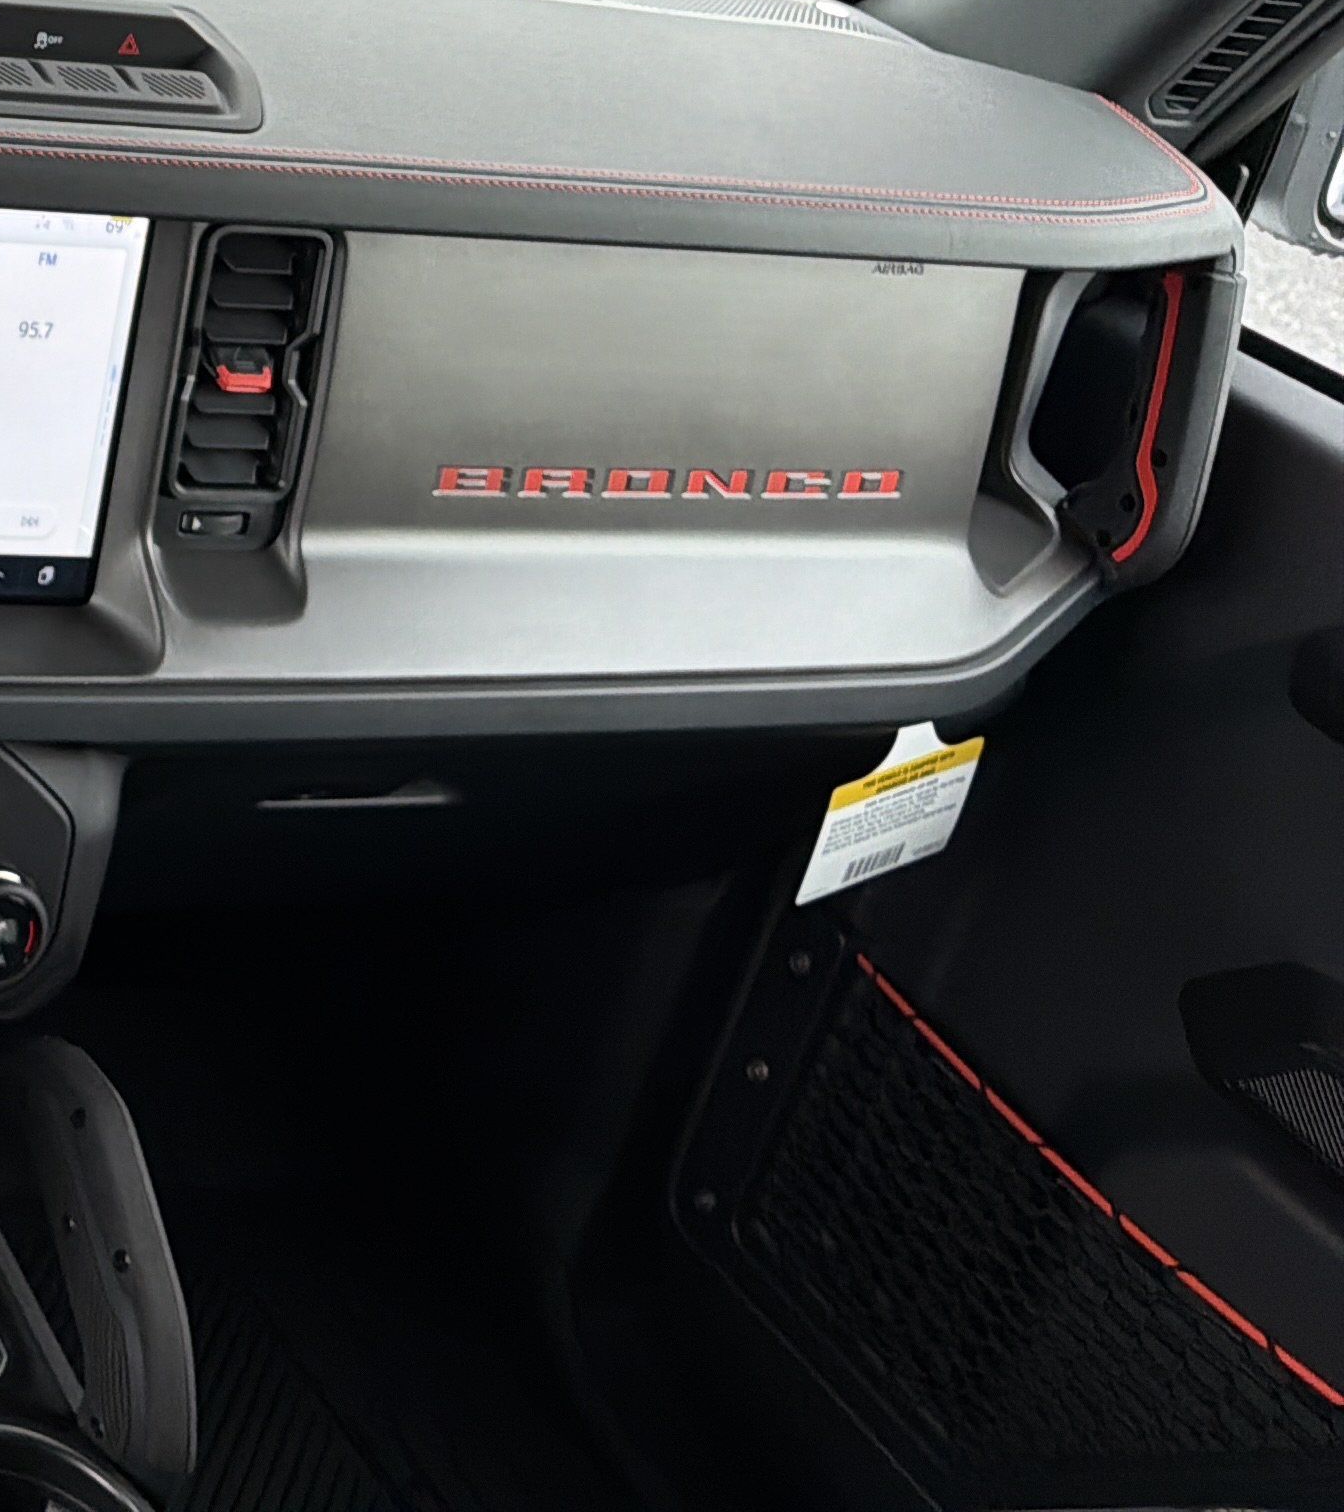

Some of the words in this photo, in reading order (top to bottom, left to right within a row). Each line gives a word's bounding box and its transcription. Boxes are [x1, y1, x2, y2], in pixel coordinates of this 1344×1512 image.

[47, 35, 63, 45] OFF
[37, 251, 59, 267] FM
[18, 320, 54, 339] 95.7
[432, 466, 903, 500] BRONCO
